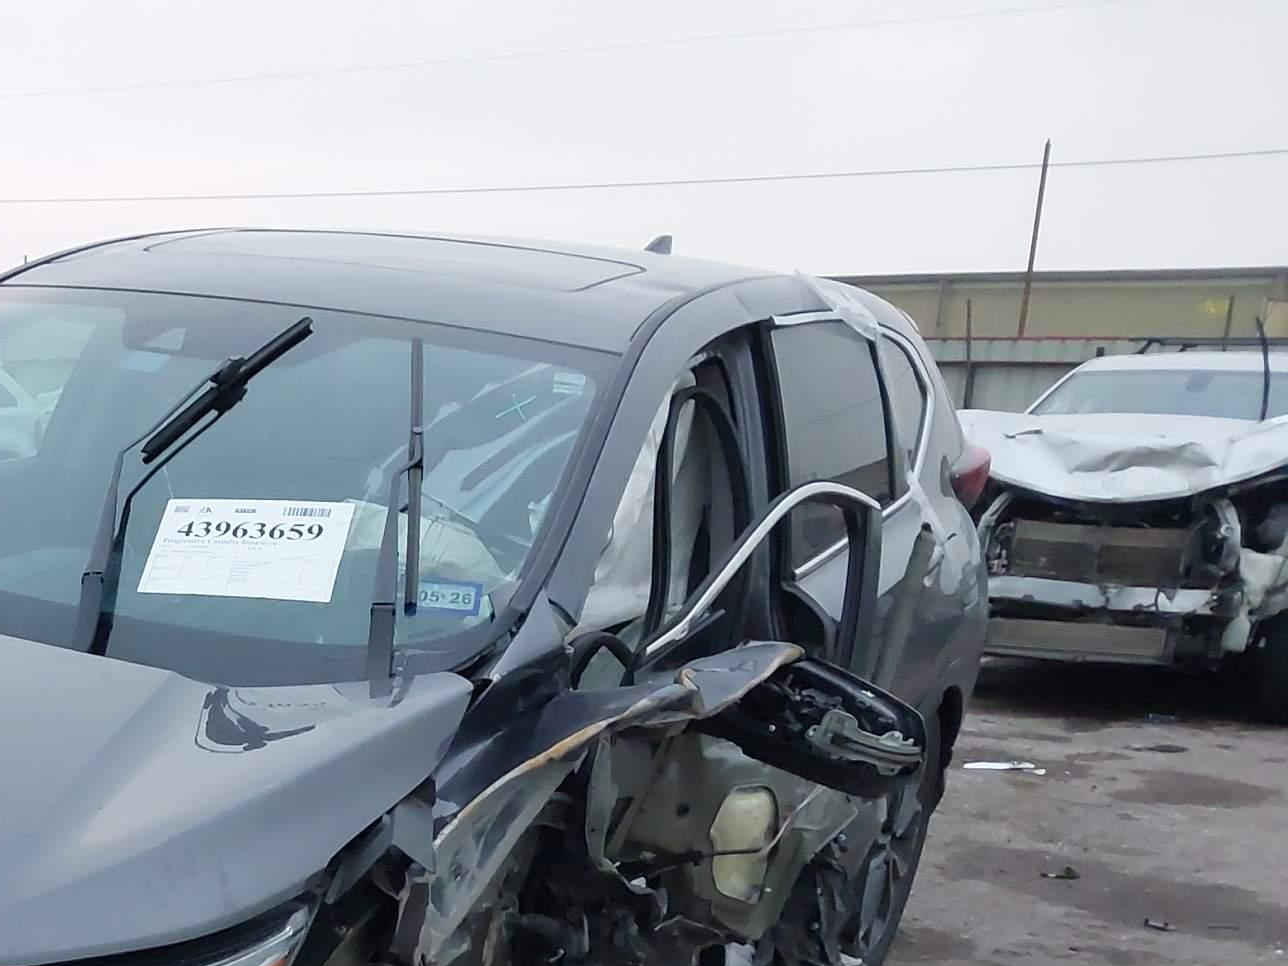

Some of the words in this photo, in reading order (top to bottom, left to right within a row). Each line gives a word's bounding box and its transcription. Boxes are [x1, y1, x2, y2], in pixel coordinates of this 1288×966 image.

[177, 520, 325, 541] 43963659
[419, 590, 440, 603] 05
[449, 592, 473, 606] 26
